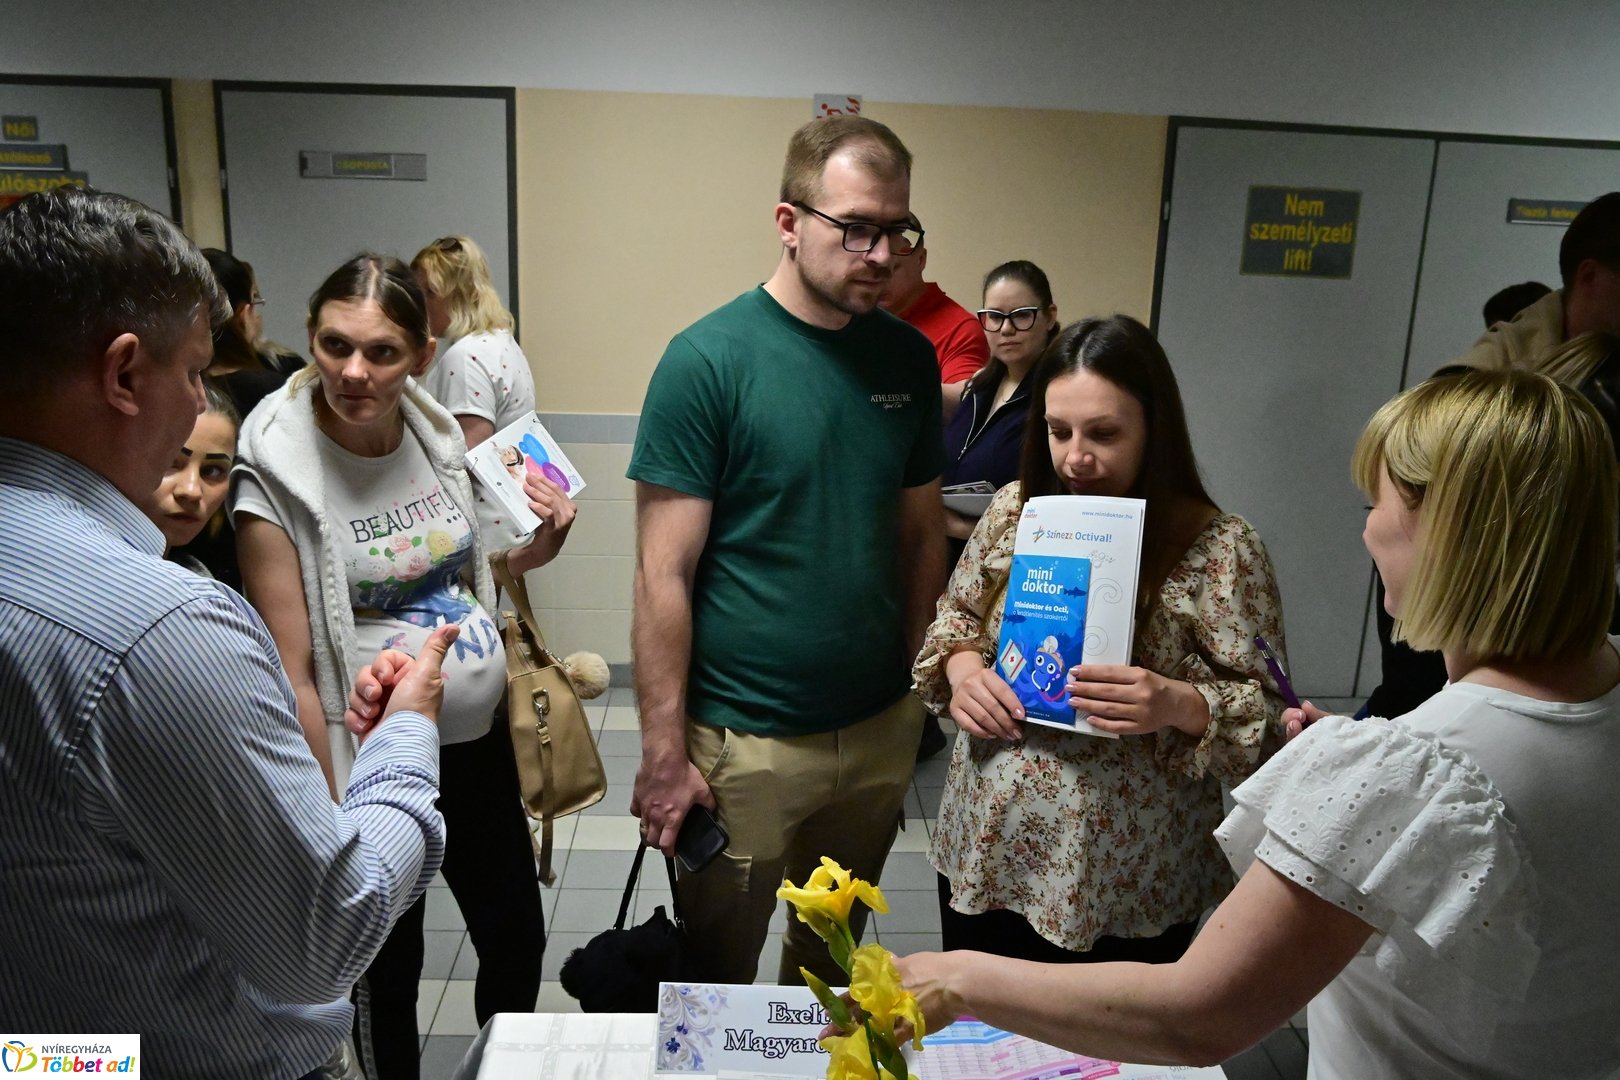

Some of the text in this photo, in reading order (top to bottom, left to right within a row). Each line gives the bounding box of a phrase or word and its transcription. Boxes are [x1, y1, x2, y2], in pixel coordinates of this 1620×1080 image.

[1285, 193, 1324, 216] Nem
[1250, 220, 1353, 248] személyzeti
[1284, 248, 1312, 271] lift!
[870, 394, 911, 402] ATHLEISURE
[1081, 510, 1134, 519] www.minidoktor.hu
[1046, 530, 1112, 543] Színezz Octival!
[1027, 566, 1053, 581] mini
[1022, 579, 1064, 595] doktor
[1053, 606, 1069, 614] Octi,
[768, 1001, 832, 1025] Exelt
[724, 1029, 831, 1059] Magyaro
